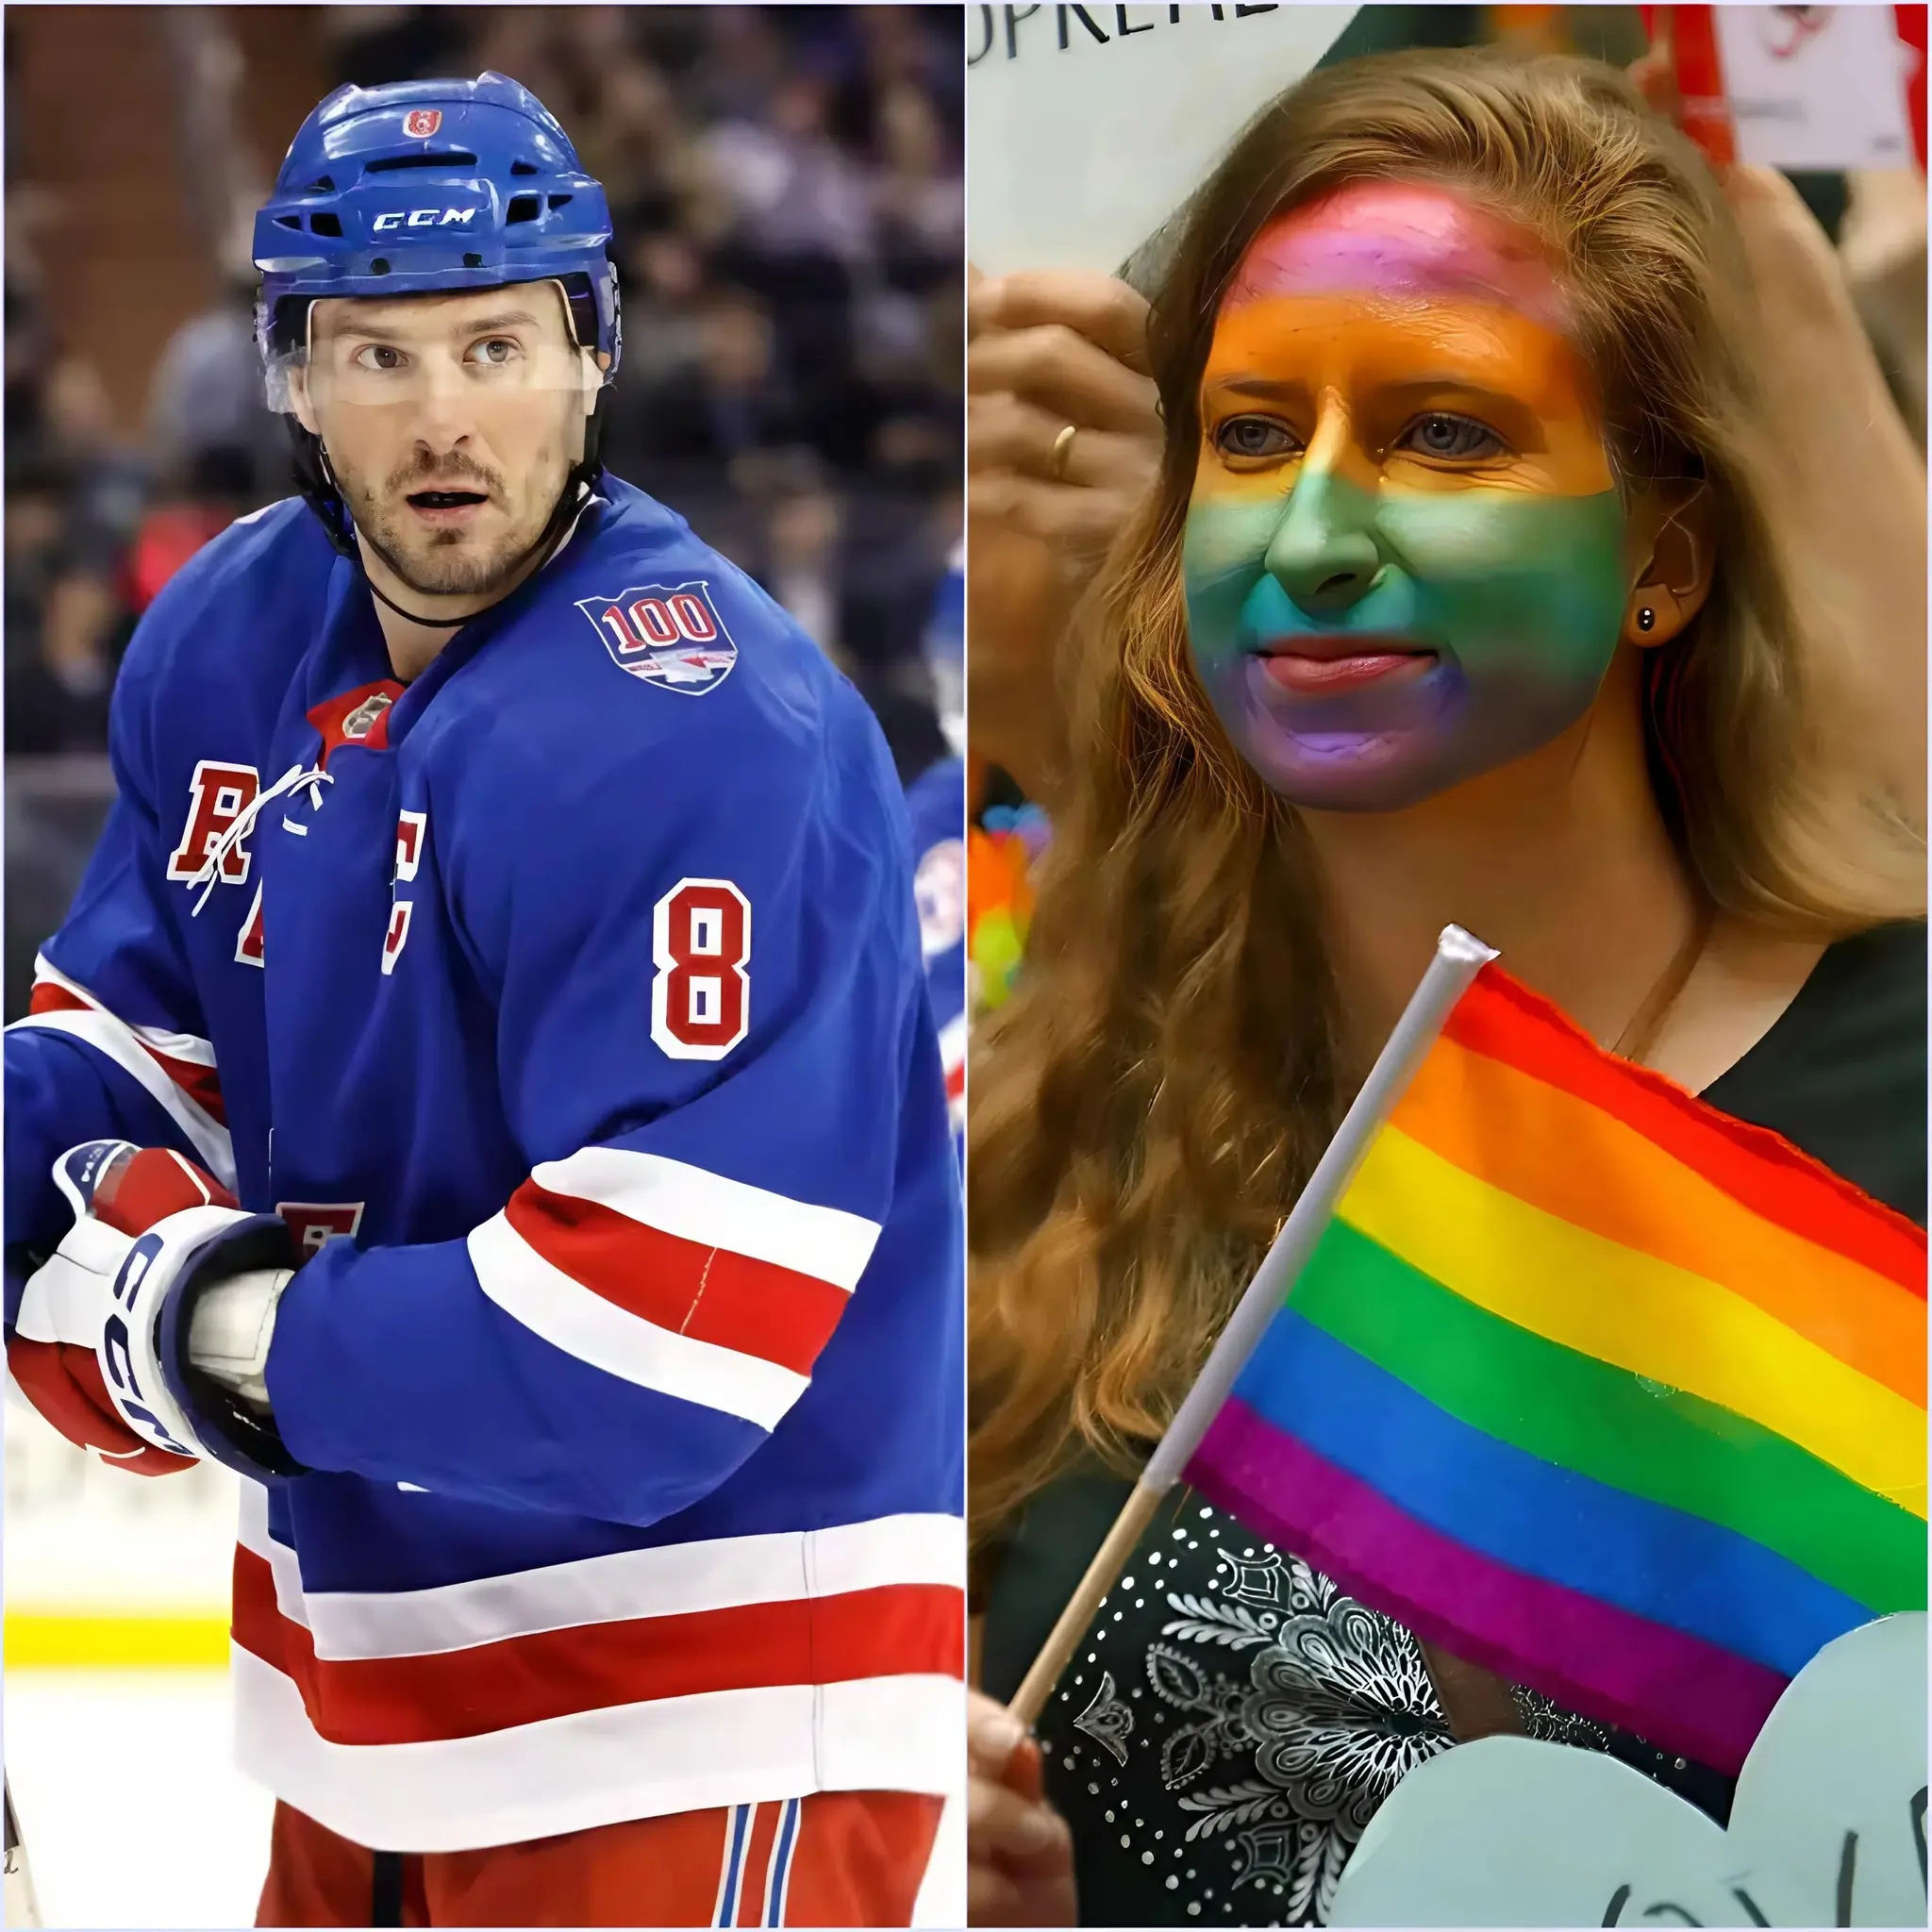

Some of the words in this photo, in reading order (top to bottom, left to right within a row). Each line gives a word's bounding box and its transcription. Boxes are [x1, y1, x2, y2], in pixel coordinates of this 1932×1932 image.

[373, 208, 475, 233] CCM
[602, 594, 717, 654] 100
[650, 877, 751, 1060] 8
